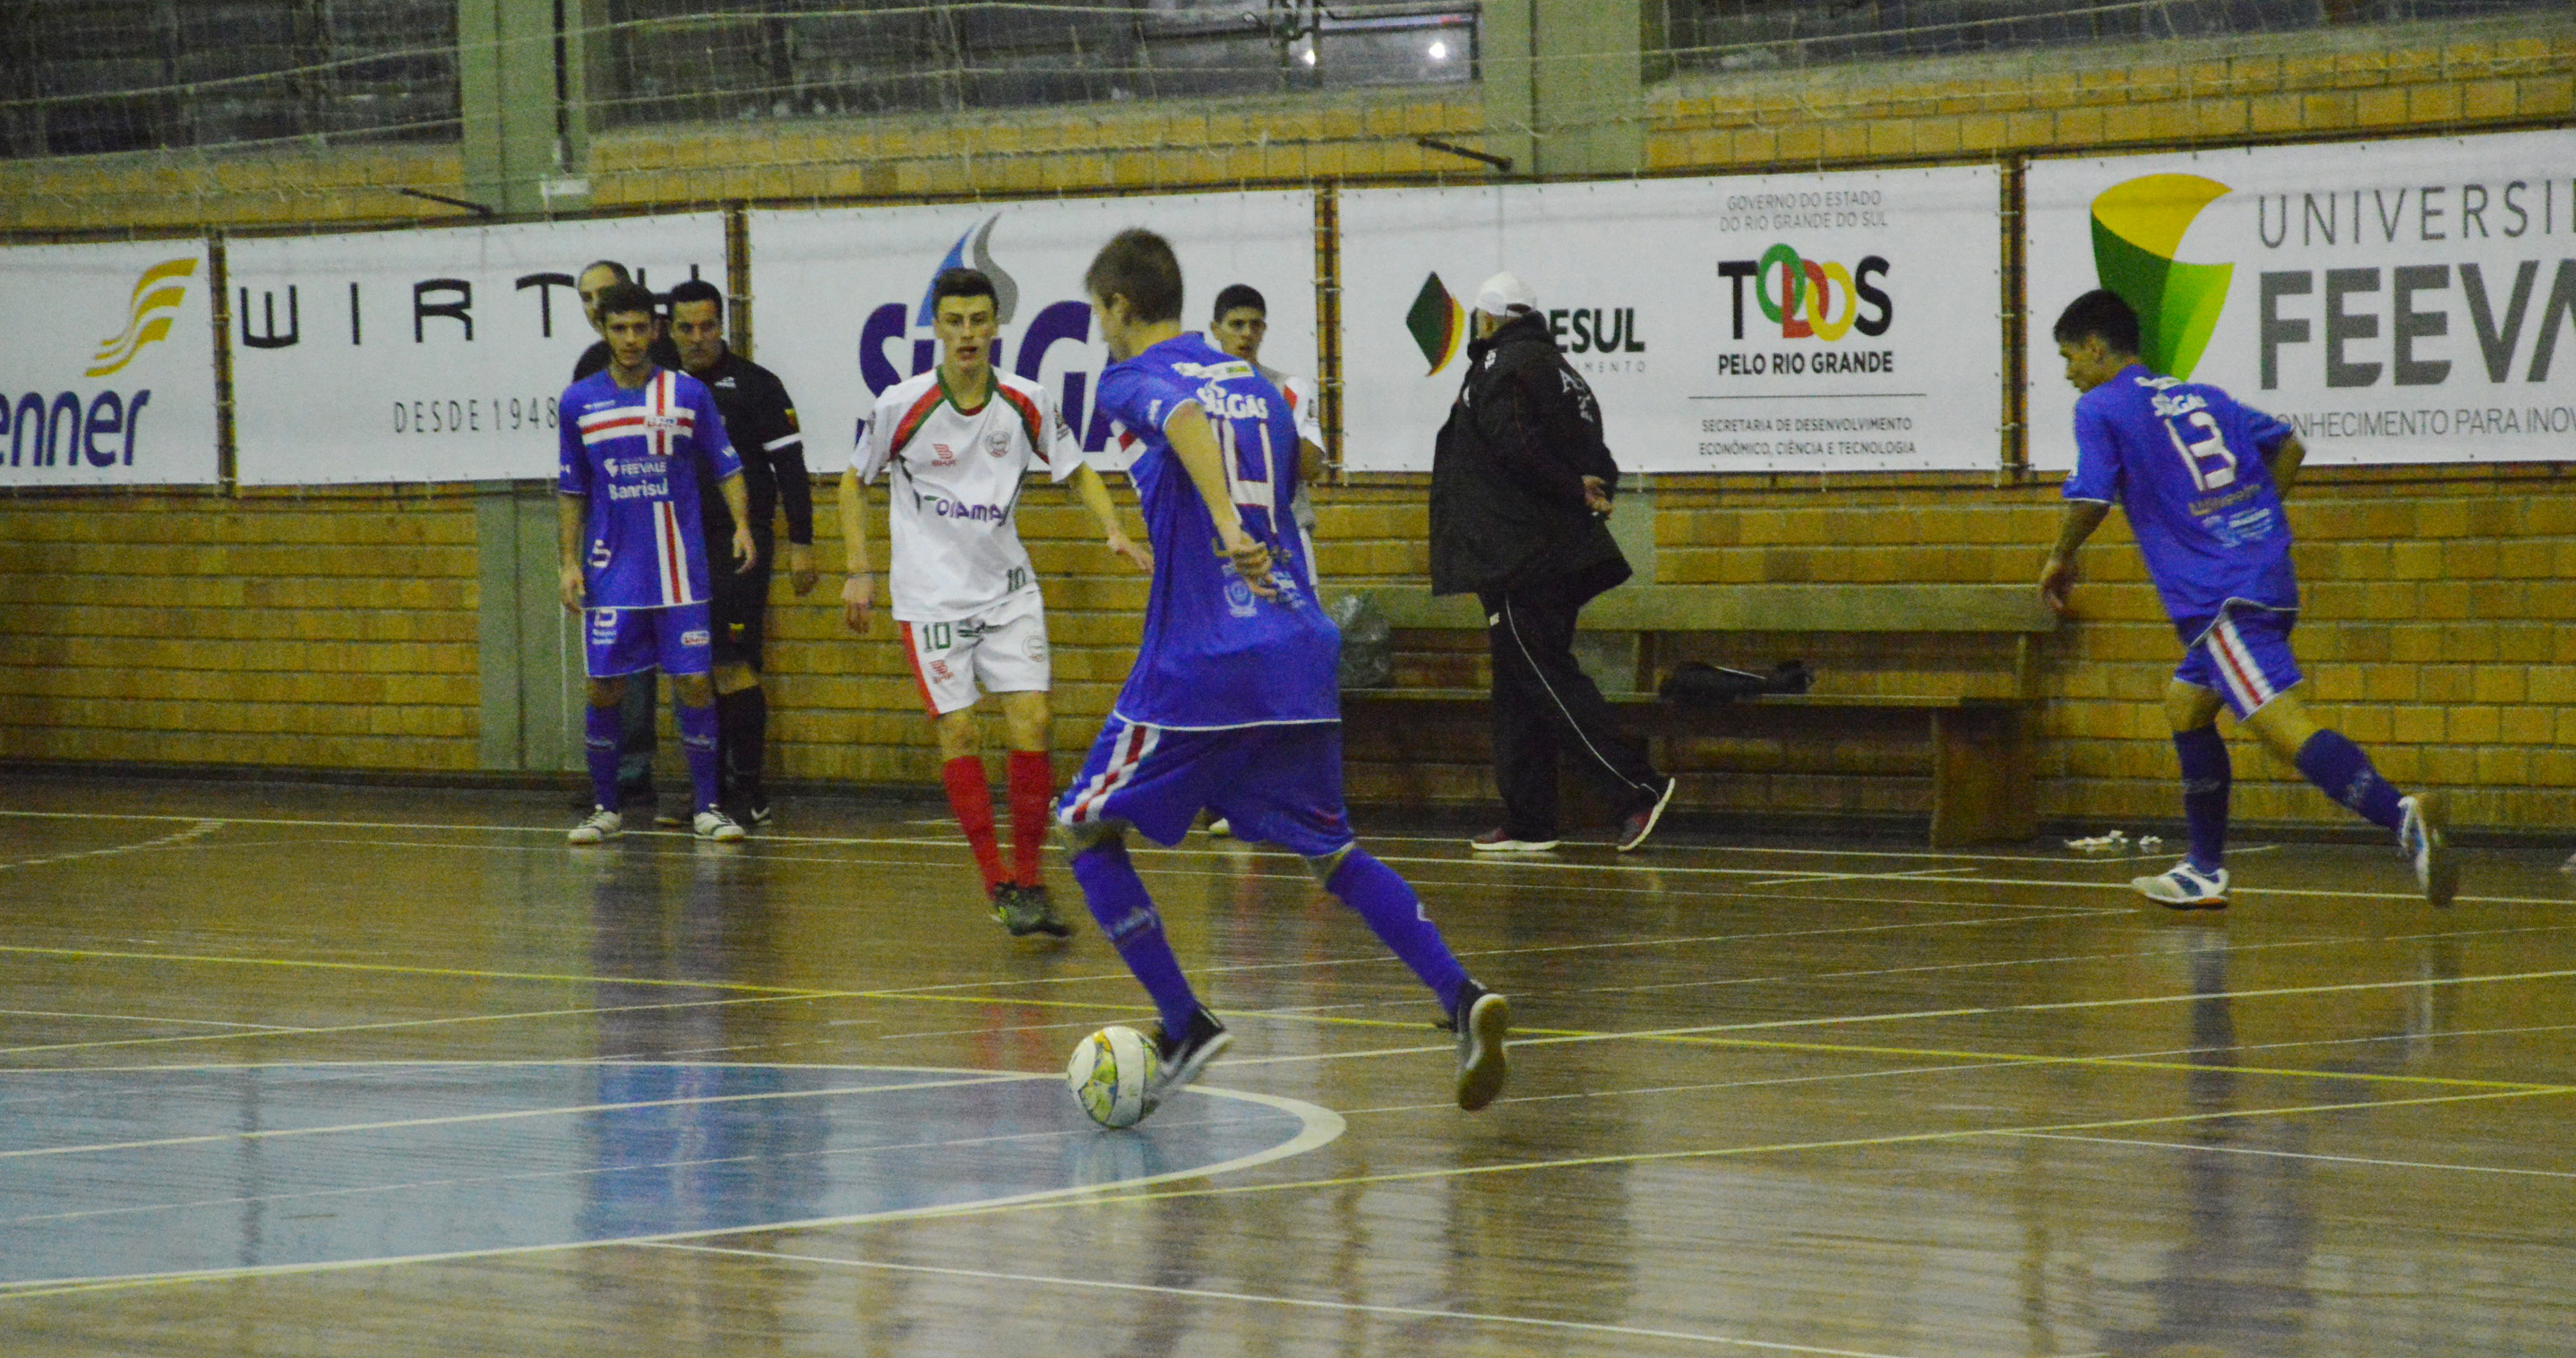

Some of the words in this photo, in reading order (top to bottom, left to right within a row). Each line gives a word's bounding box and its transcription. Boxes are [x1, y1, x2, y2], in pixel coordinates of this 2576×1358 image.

[1727, 193, 1795, 211] GOVERNO
[1799, 192, 1821, 208] DO
[1825, 190, 1881, 207] ESTADO
[2260, 178, 2576, 249] UNIVERSI
[1720, 216, 1740, 232] DO
[1746, 215, 1769, 230] RIO
[1773, 212, 1831, 230] GRANDE
[1837, 211, 1858, 228] DO
[1862, 211, 1888, 227] SUL
[240, 263, 700, 348] WIRT
[1717, 243, 1893, 342] TODOS
[1718, 353, 1766, 375] PELO
[1773, 352, 1805, 374] RIO
[1811, 350, 1893, 374] GRANDE
[394, 400, 480, 434] DESDE
[493, 396, 560, 431] 1948
[1702, 418, 1773, 433] SECRETARIA
[1776, 418, 1791, 432] DE
[1795, 417, 1913, 431] DESENVOLVIMENTO
[2455, 408, 2520, 434] PARA
[1827, 442, 1834, 455] E
[1838, 441, 1917, 455] TECNOLOGIA
[2163, 410, 2238, 494] 13
[1006, 565, 1027, 593] 10
[923, 622, 951, 653] 10
